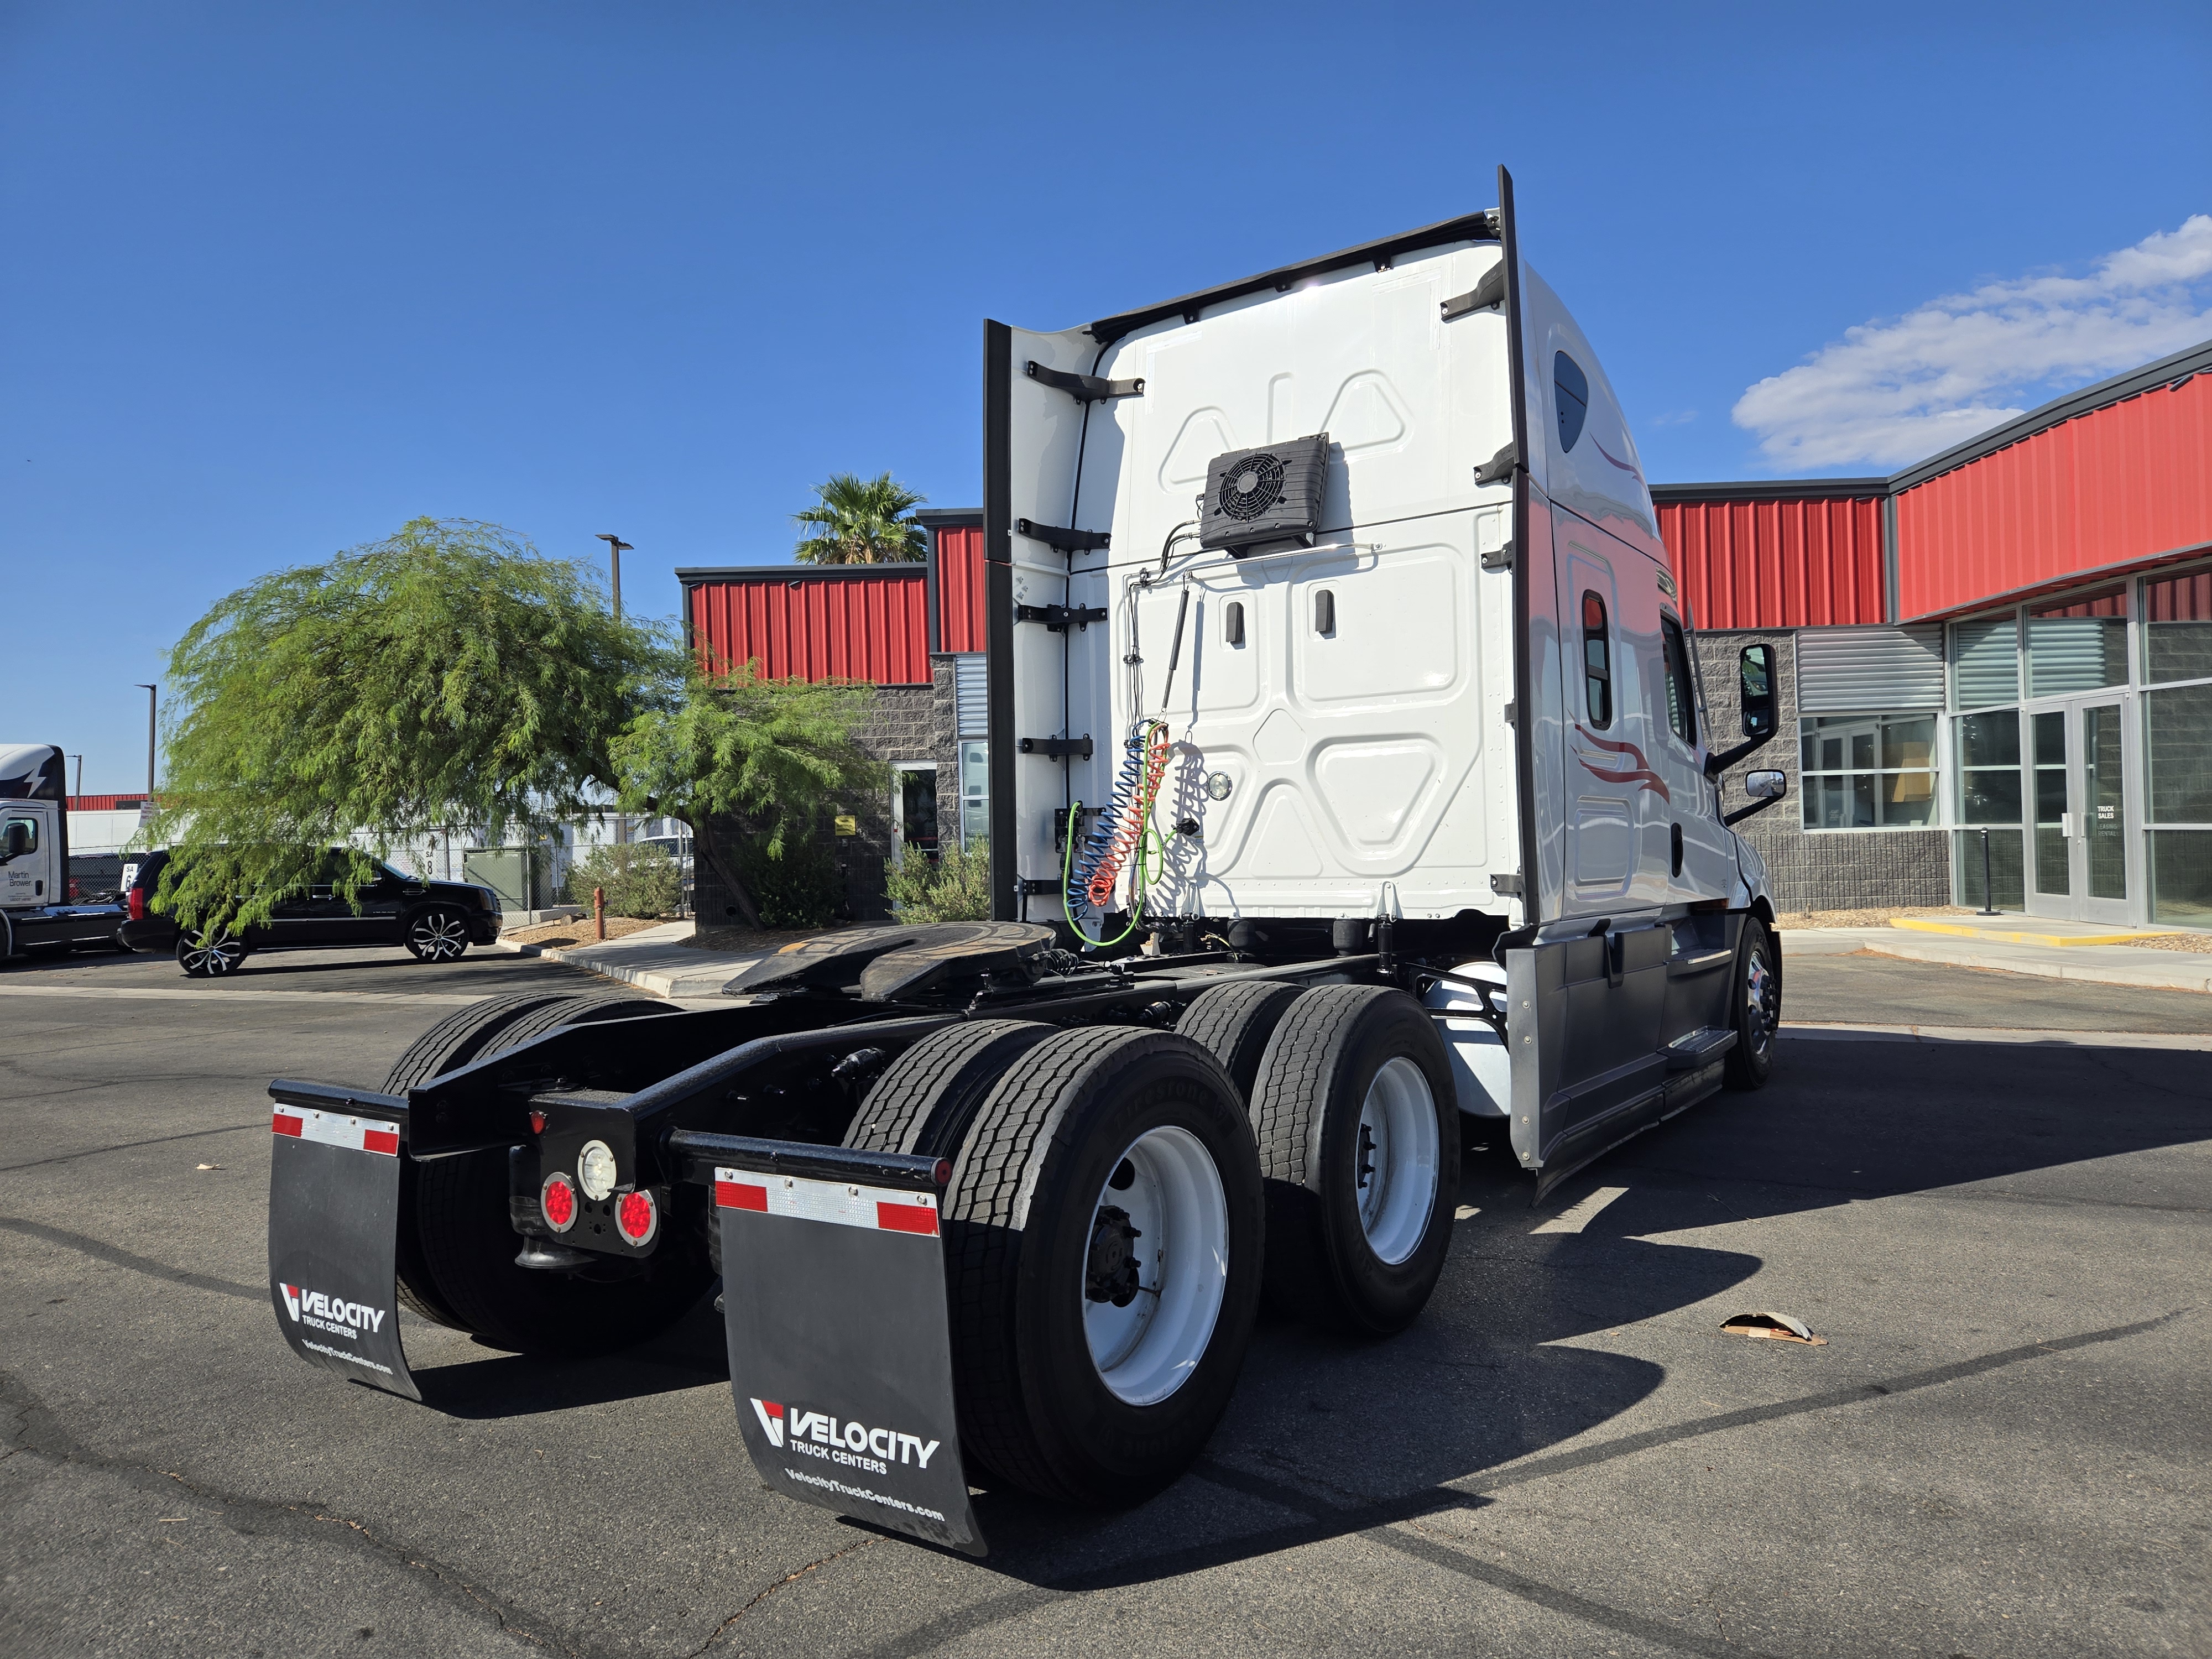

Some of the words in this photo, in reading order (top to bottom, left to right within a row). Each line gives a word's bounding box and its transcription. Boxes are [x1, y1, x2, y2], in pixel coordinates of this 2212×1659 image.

[126, 875, 132, 888] 6
[427, 860, 433, 875] 8
[1113, 1078, 1210, 1129] Firestone
[301, 1288, 385, 1333] VELOCITY
[302, 1314, 326, 1330] TRUCK
[325, 1322, 357, 1340] CENTERS
[301, 1339, 394, 1375] VelocityTruckCenters.com
[790, 1407, 940, 1469] VELOCITY
[790, 1439, 830, 1460] TRUCK
[832, 1450, 887, 1475] CENTERS
[784, 1468, 945, 1522] VelocityTruckCenters.com
